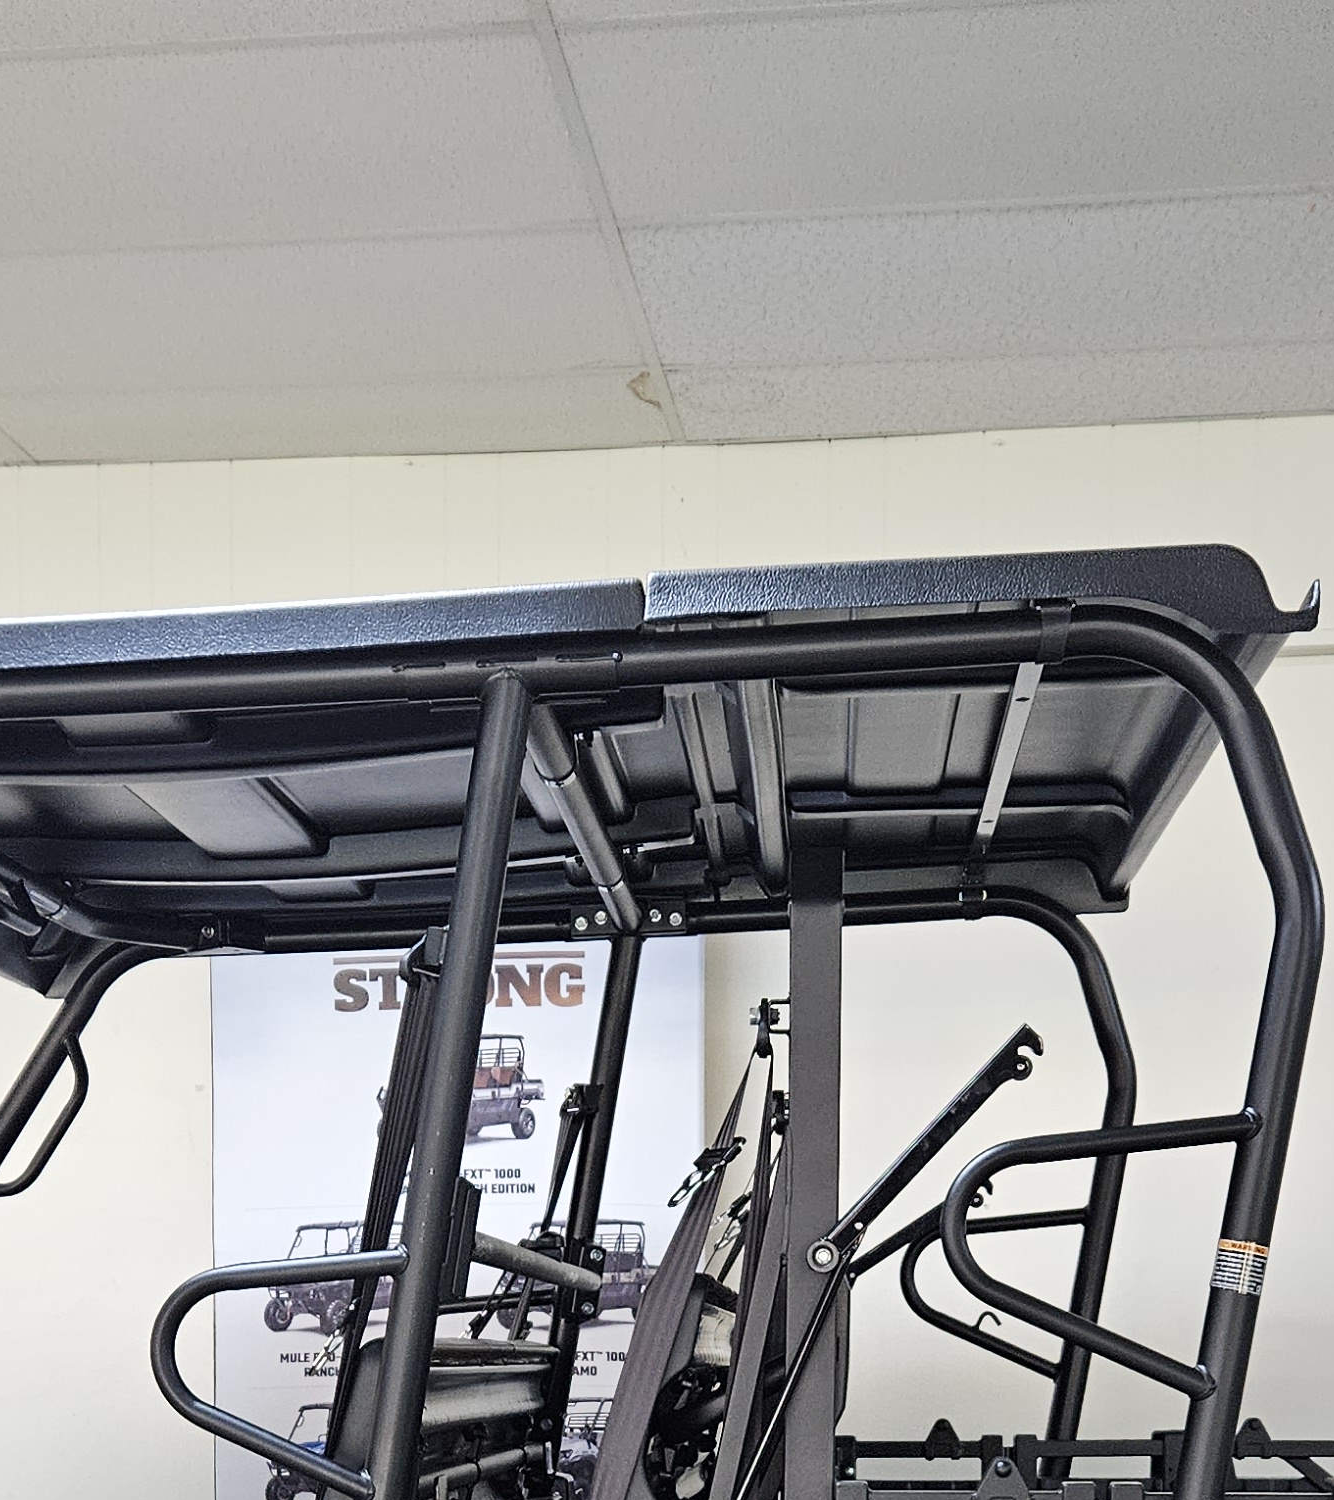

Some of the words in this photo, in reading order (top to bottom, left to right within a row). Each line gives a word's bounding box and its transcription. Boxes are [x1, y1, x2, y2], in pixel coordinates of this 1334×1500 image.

[333, 963, 585, 1012] STNG
[494, 1168, 521, 1179] 1000
[491, 1183, 536, 1194] EDITION
[280, 1353, 310, 1363] MULE
[605, 1351, 627, 1362] 100
[571, 1365, 597, 1376] AMO
